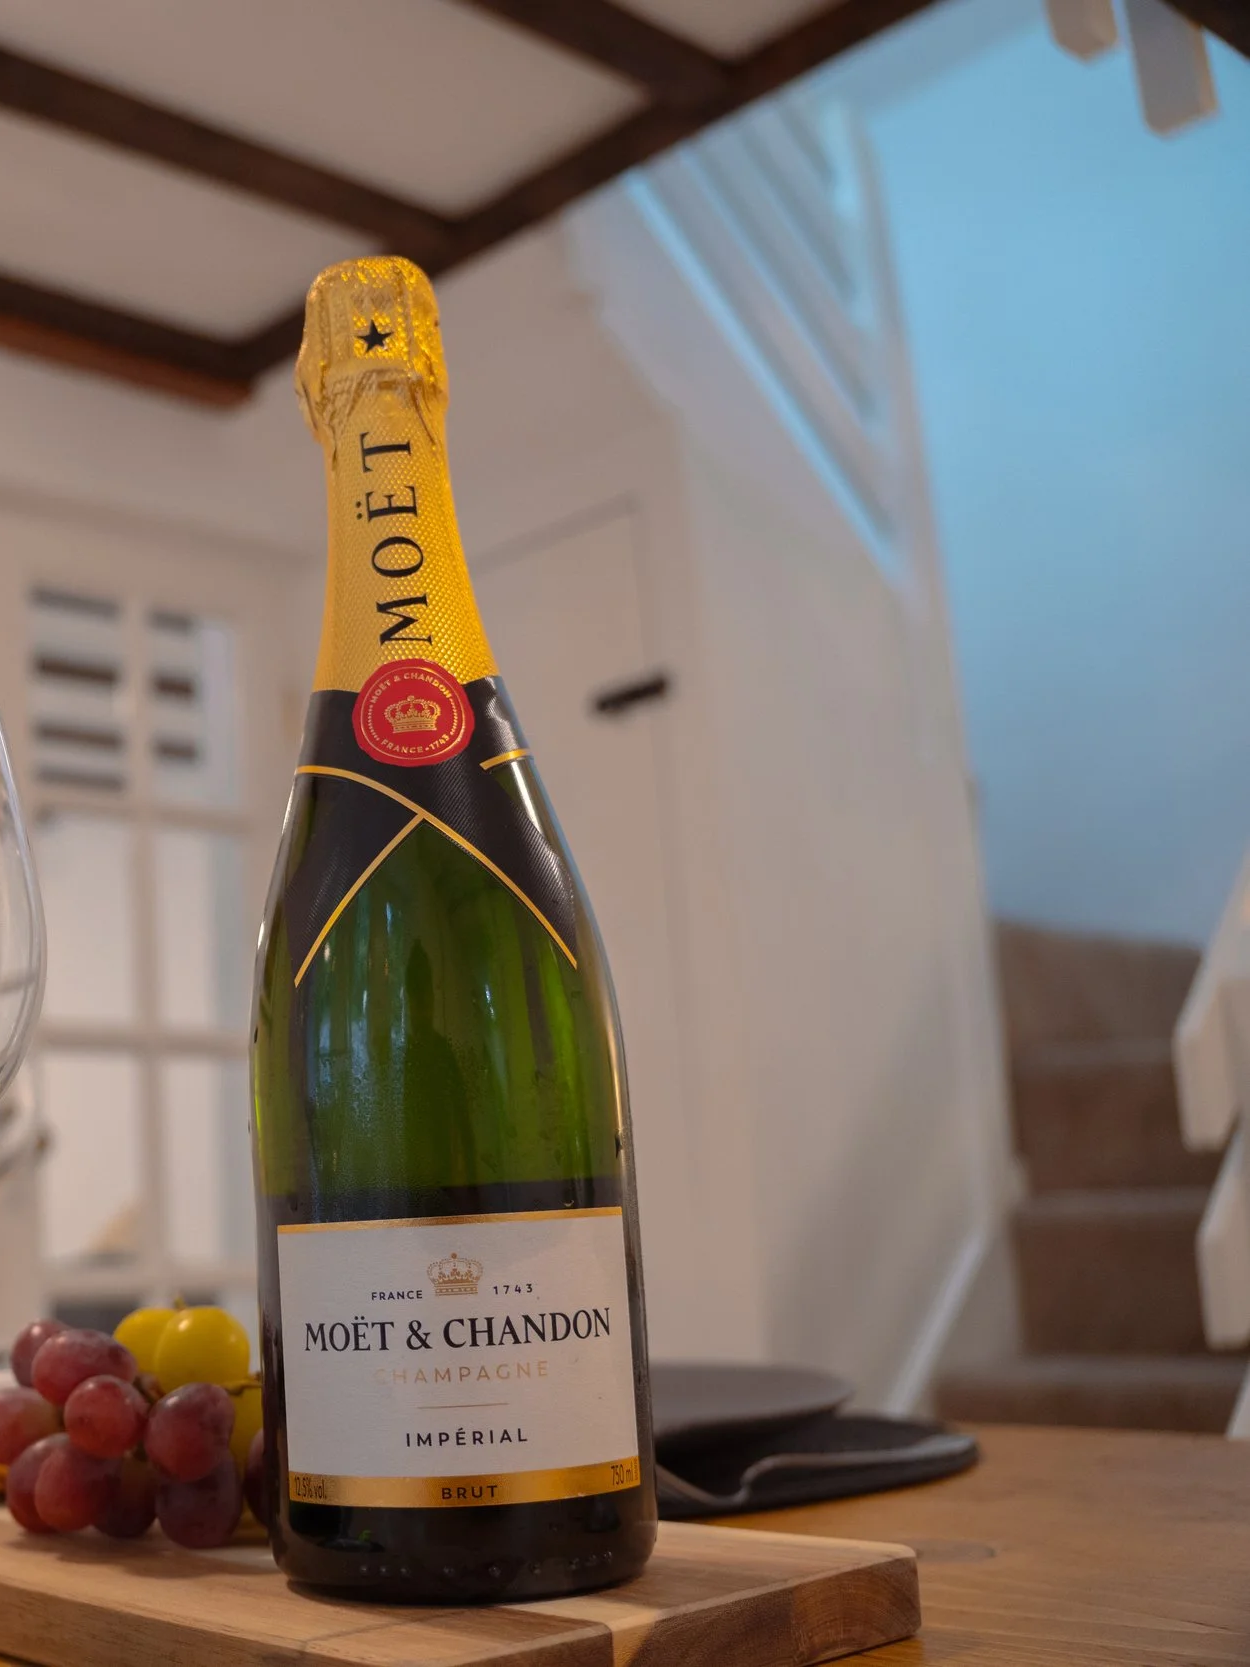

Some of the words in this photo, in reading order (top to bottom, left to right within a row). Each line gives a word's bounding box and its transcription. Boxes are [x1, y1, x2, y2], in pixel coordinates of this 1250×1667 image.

[356, 432, 432, 645] MOËT
[404, 673, 452, 698] CHANDON
[381, 739, 423, 753] FRANCE
[429, 733, 450, 750] 1743
[371, 1289, 423, 1301] FRANCE
[493, 1283, 534, 1295] 1743
[304, 1315, 395, 1352] MOËT
[405, 1319, 432, 1351] &
[442, 1307, 611, 1348] CHANDON
[373, 1360, 548, 1385] CHAMPAGNE
[406, 1427, 528, 1447] IMPÉRIAL
[441, 1484, 498, 1500] BRUT
